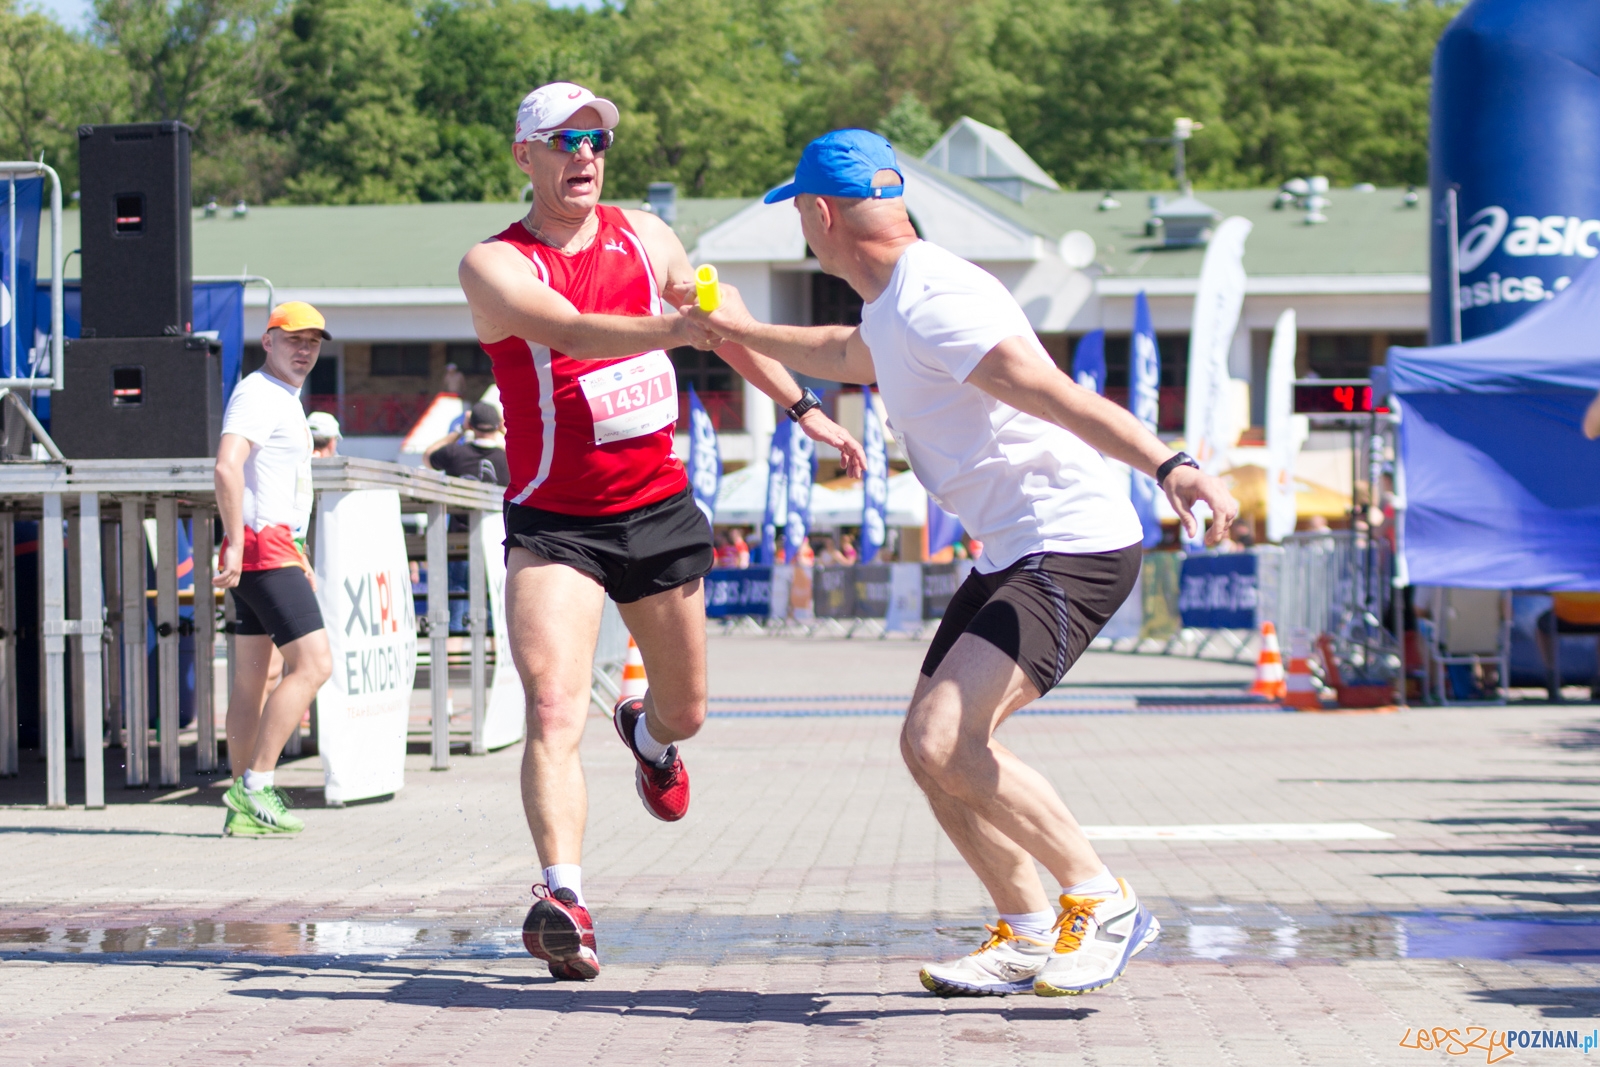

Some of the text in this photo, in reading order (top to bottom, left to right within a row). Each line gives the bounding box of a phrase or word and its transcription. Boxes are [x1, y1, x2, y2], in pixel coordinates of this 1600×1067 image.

[1504, 216, 1600, 259] asic
[601, 377, 664, 415] 143/1
[345, 644, 402, 696] EKIDEN
